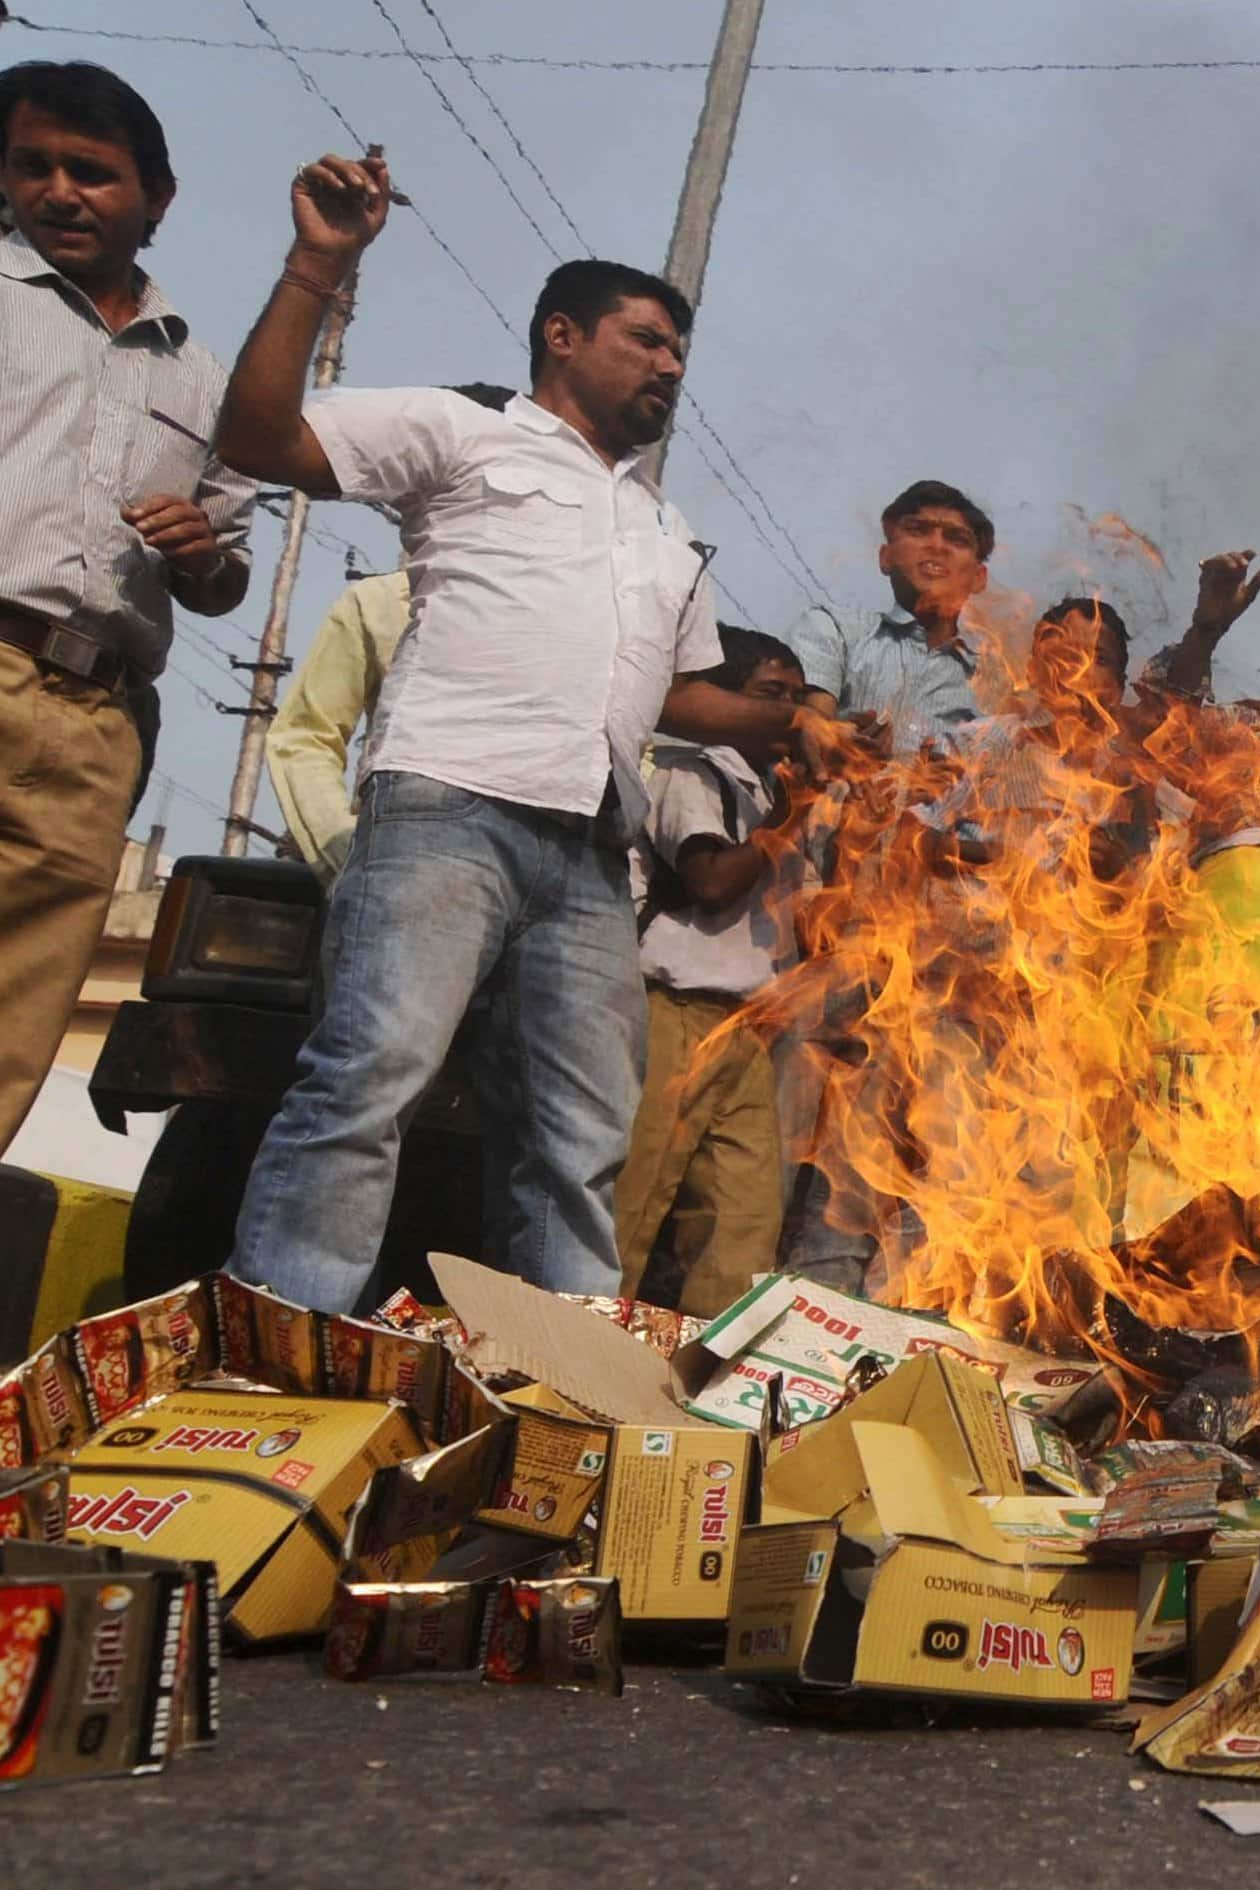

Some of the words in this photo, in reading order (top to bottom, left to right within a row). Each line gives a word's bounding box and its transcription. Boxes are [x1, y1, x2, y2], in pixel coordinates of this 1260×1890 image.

[150, 1426, 259, 1454] Tulsi
[68, 1487, 191, 1541] ulsi
[698, 1484, 731, 1544] Tulsi
[923, 1575, 985, 1597] TOBACCO
[82, 1614, 127, 1705] Tulsi
[159, 1586, 186, 1688] TOBACCO
[975, 1616, 1056, 1676] Tulsi
[150, 1694, 173, 1757] KILLS
